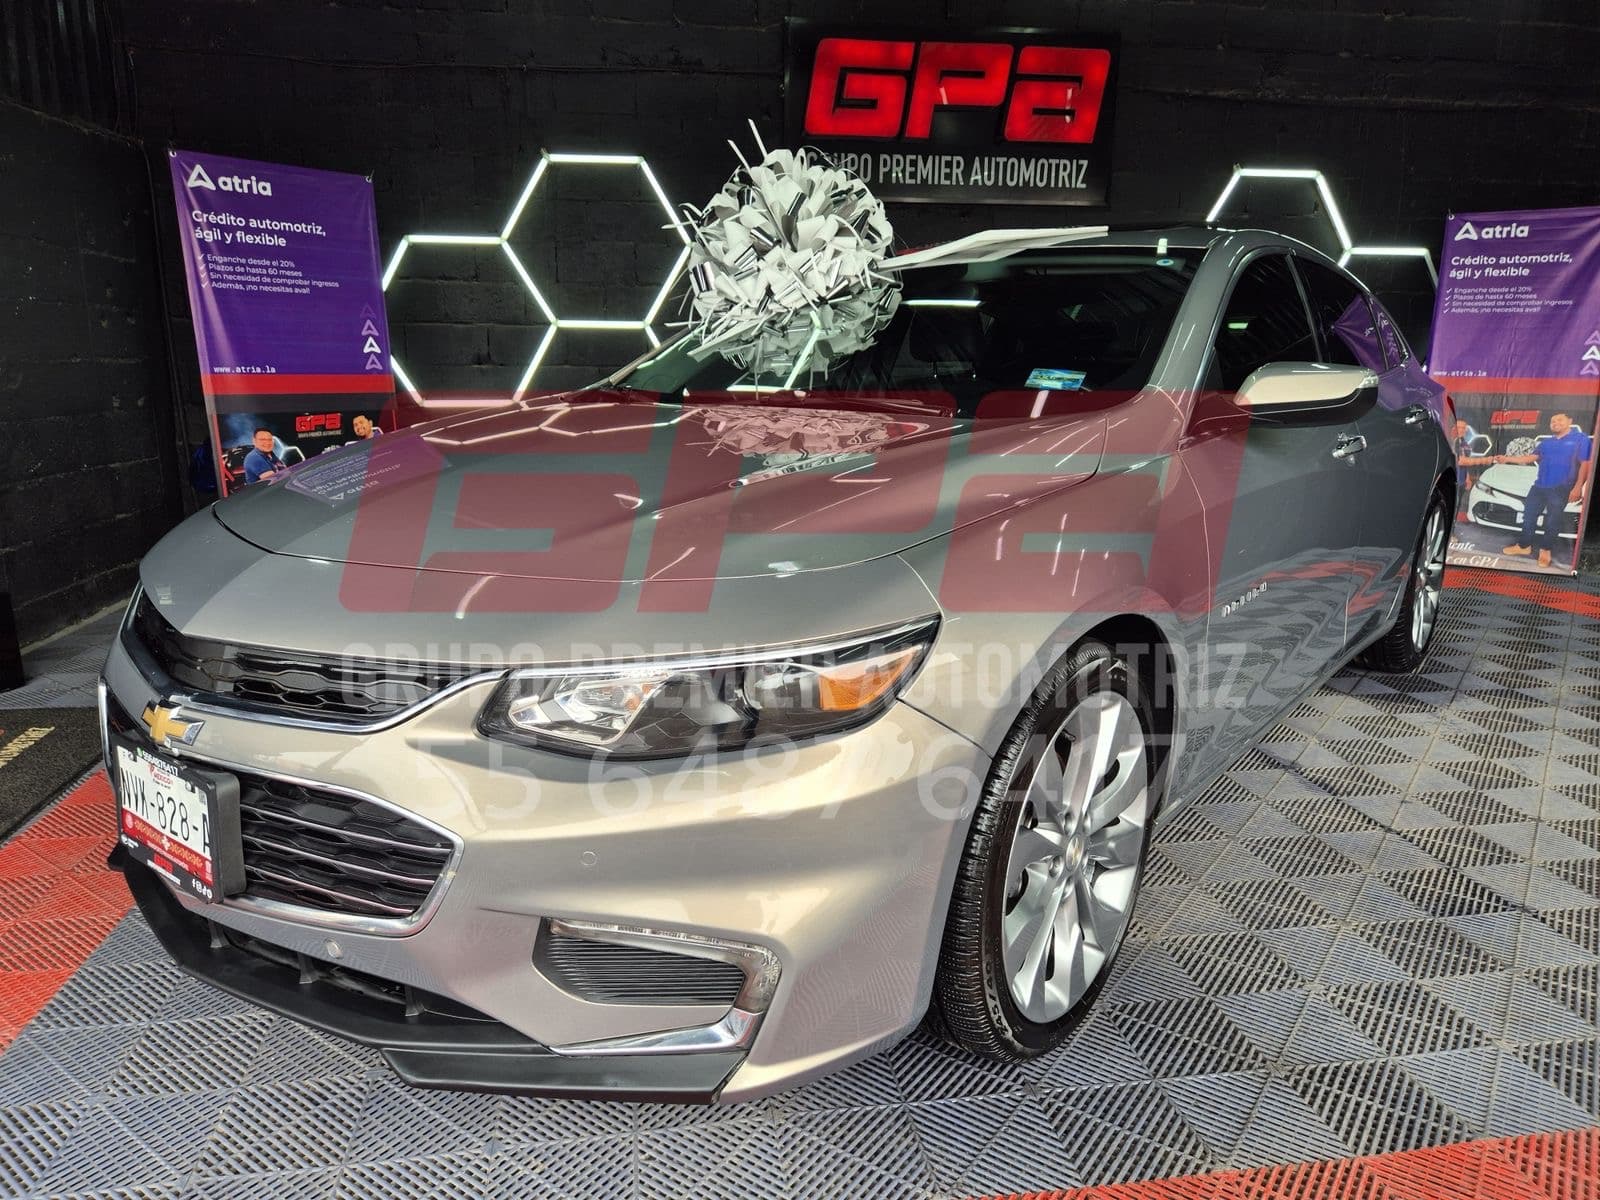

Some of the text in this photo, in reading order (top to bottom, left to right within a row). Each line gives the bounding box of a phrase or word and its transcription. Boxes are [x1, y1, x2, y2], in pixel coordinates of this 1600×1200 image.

[879, 153, 964, 185] PREMIER
[970, 156, 1089, 189] AUTOMOTRIZ
[218, 175, 272, 196] atria
[192, 210, 326, 237] Crédito automotriz,
[195, 227, 287, 247] ágil y flexible
[1481, 223, 1529, 239] atria
[207, 254, 246, 265] Enganche
[248, 257, 271, 266] desde
[280, 260, 295, 268] 20%
[1451, 252, 1573, 266] Crédito automotriz,
[209, 263, 233, 272] Plazos
[235, 265, 245, 273] de
[246, 266, 267, 275] hasta
[268, 268, 278, 276] 60
[1449, 267, 1530, 279] ágil y flexible
[210, 272, 222, 280] Sin
[223, 273, 260, 283] necesidad
[272, 277, 310, 286] comprobar
[312, 279, 339, 288] ingresos
[260, 285, 293, 293] necesitas
[213, 364, 276, 374] www.atria.la
[1433, 369, 1487, 377] www.atria.la
